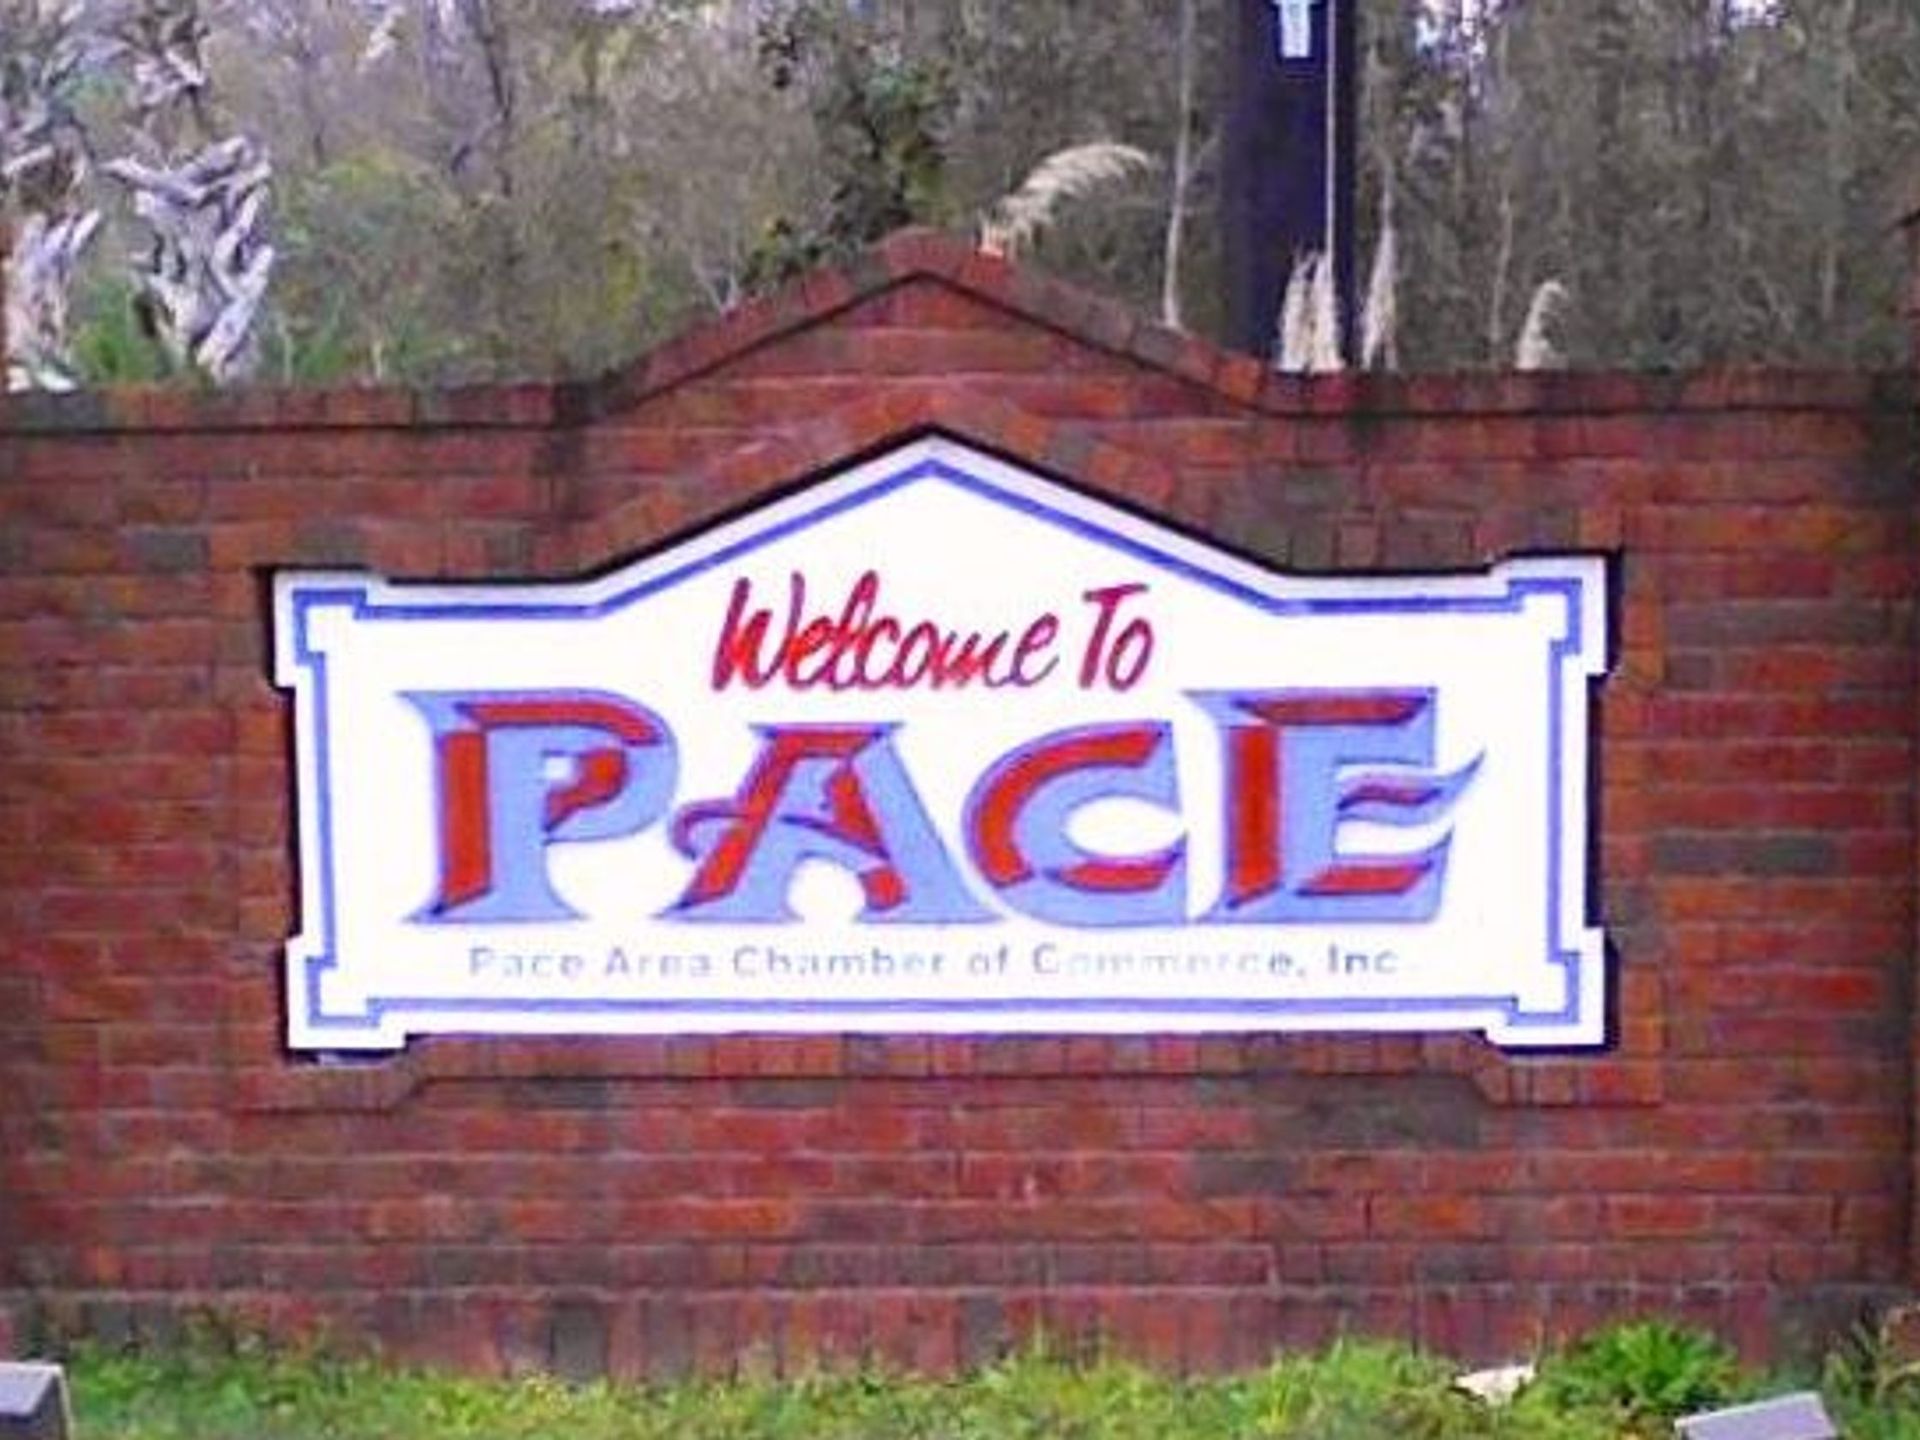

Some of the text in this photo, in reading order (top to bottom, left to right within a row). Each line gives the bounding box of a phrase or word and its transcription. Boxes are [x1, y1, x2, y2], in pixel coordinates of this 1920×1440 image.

[711, 570, 1155, 692] Welcome To
[398, 687, 1486, 928] PACE
[468, 946, 585, 977] Pace
[604, 946, 712, 977] Area
[732, 945, 946, 977] Chamber
[968, 944, 1009, 976] of
